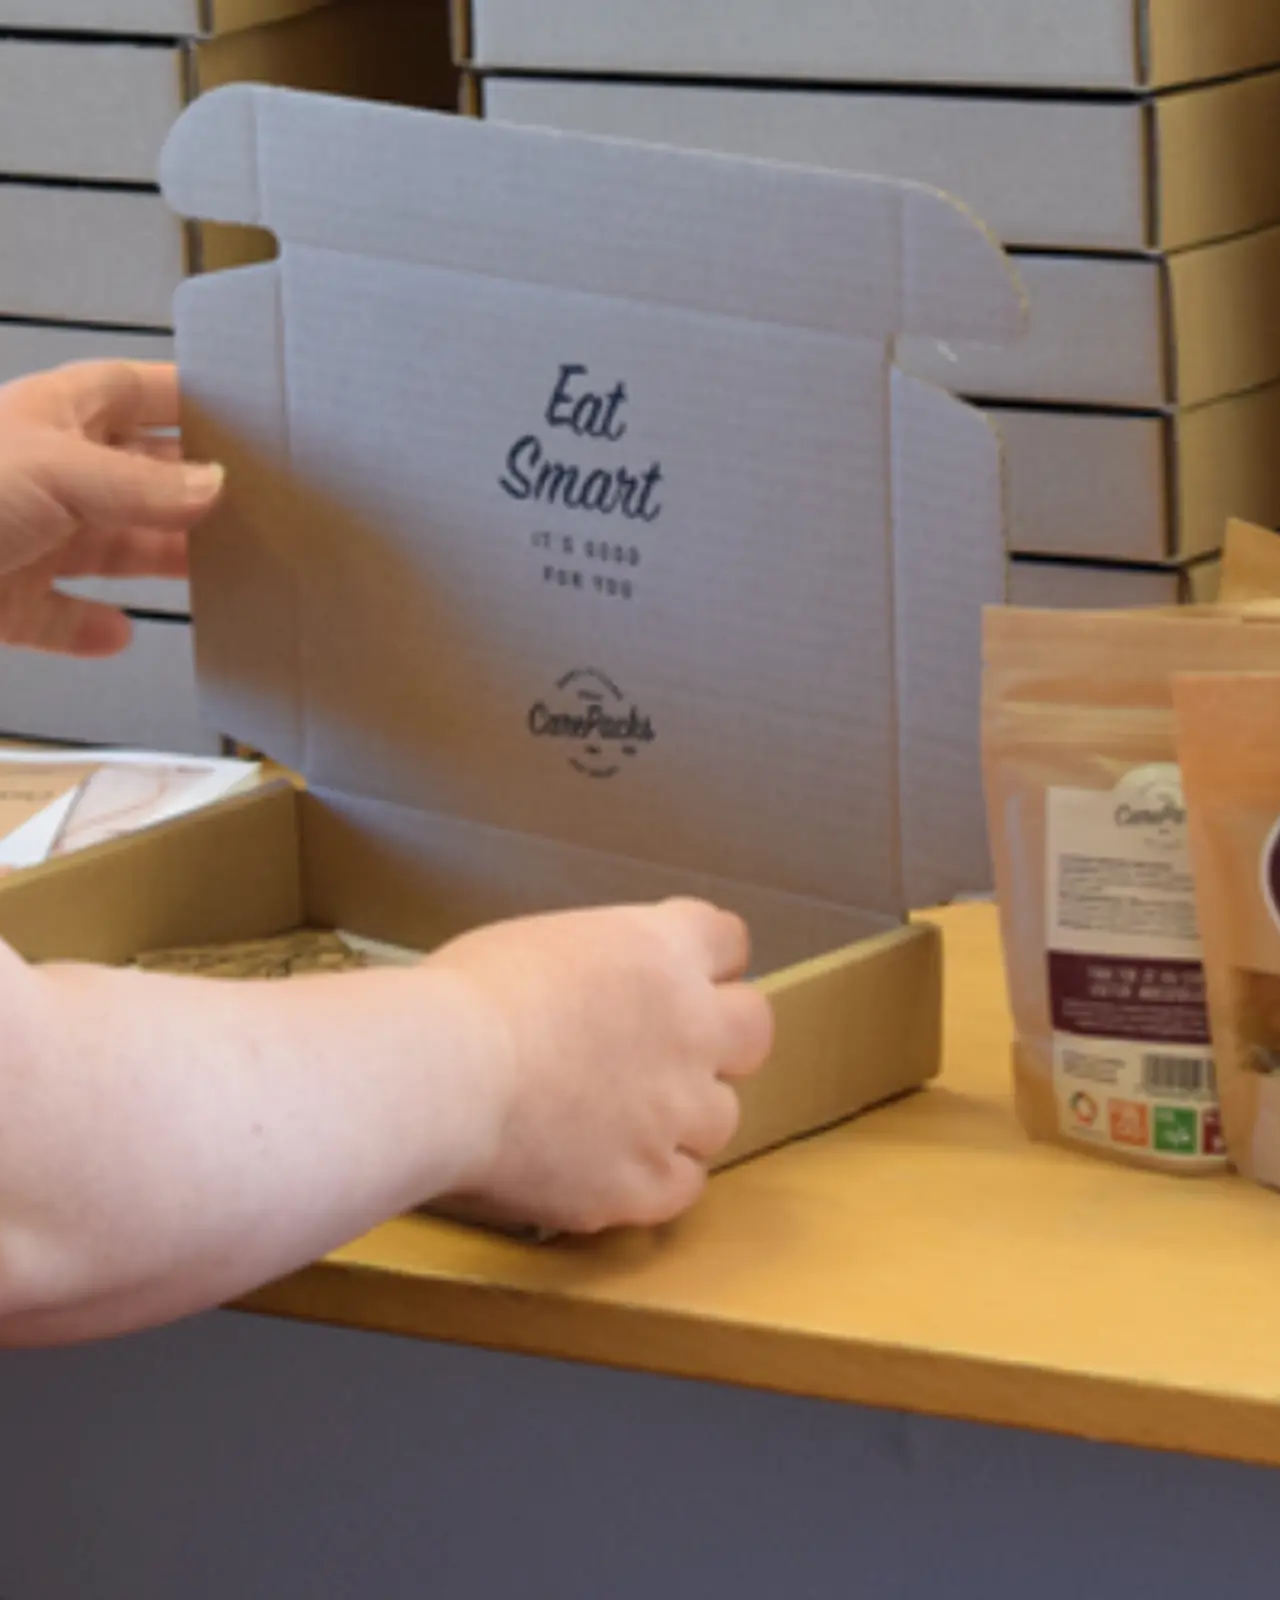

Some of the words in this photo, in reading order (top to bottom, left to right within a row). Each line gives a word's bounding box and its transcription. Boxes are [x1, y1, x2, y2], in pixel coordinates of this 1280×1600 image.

[544, 364, 628, 442] Eat
[498, 434, 663, 523] Smart
[584, 540, 641, 568] GOOD
[542, 564, 583, 590] FOR
[591, 575, 634, 601] YOU
[526, 700, 657, 744] CarePacks
